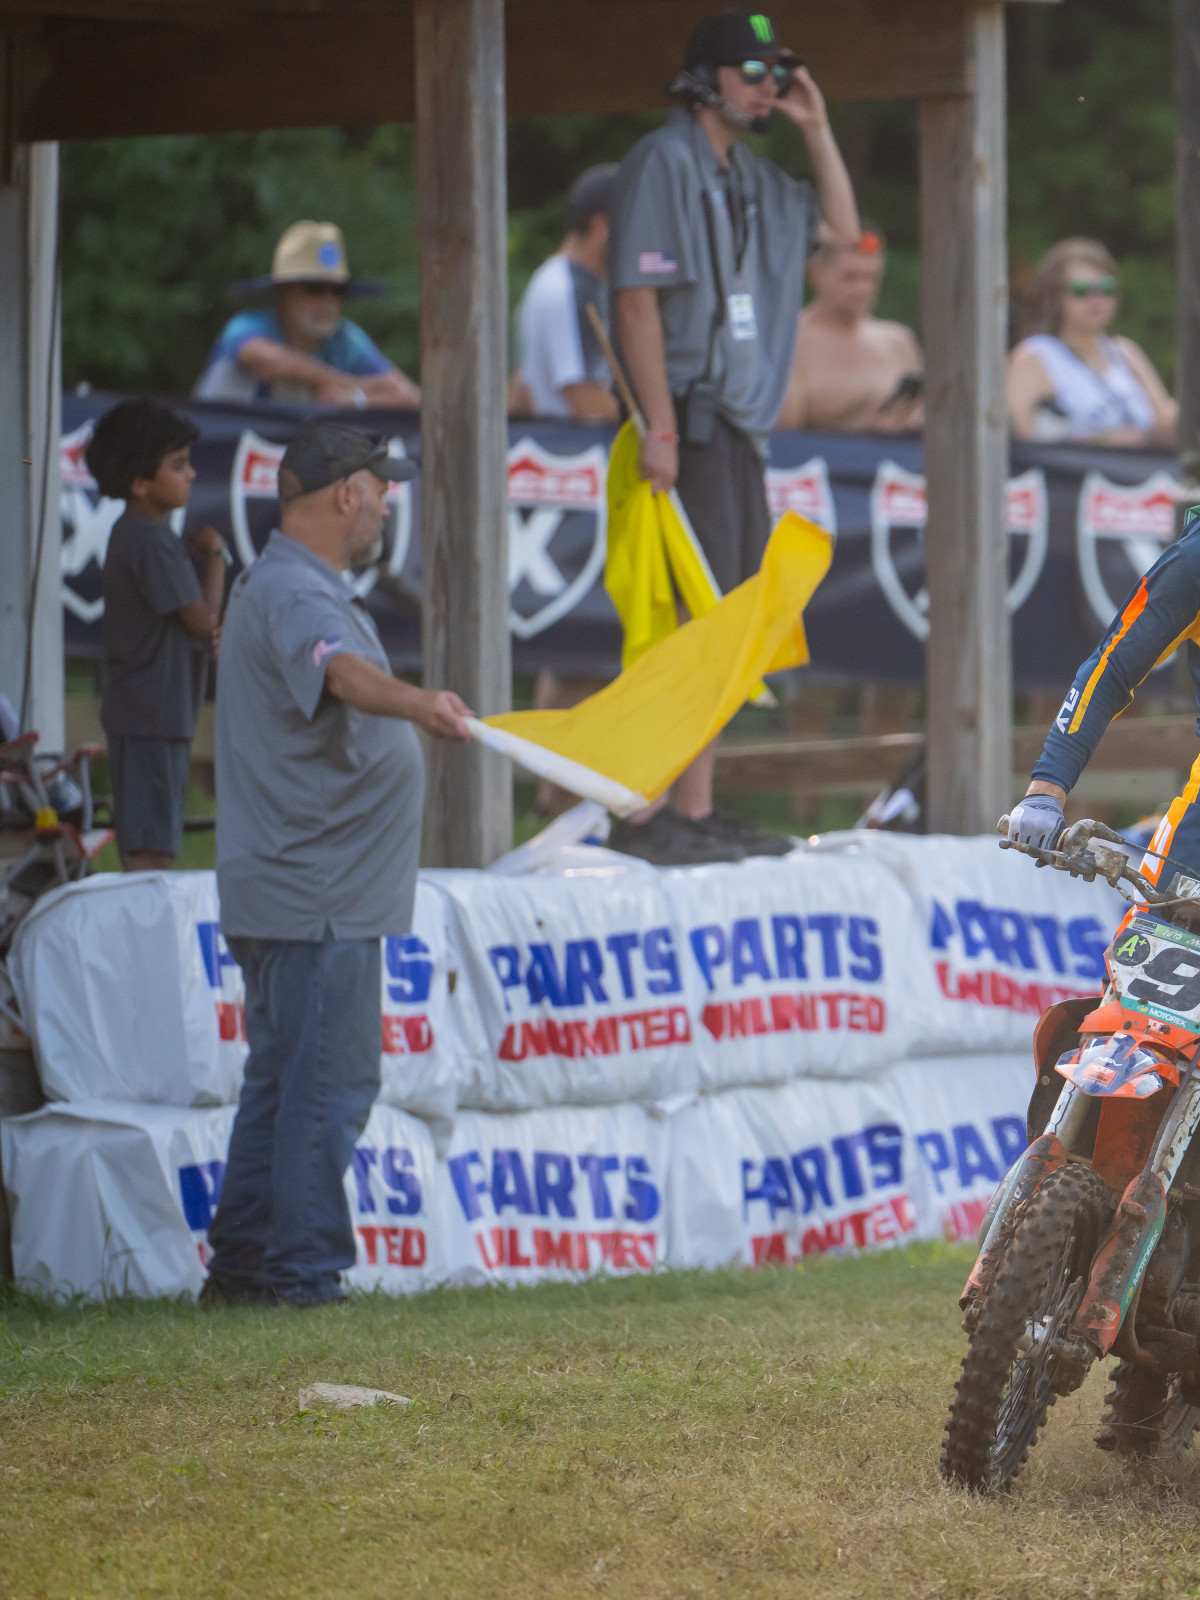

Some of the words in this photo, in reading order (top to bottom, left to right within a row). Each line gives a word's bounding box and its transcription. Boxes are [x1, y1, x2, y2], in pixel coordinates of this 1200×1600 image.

[488, 926, 683, 1012] PARTS
[689, 914, 884, 992] PARTS
[1148, 1007, 1188, 1027] MOTOREX
[447, 1148, 661, 1223] PARTS
[741, 1120, 905, 1224] PARTS
[917, 1115, 1028, 1195] PAR
[1183, 1181, 1200, 1194] Twin
[1133, 1229, 1160, 1287] MOTOREX
